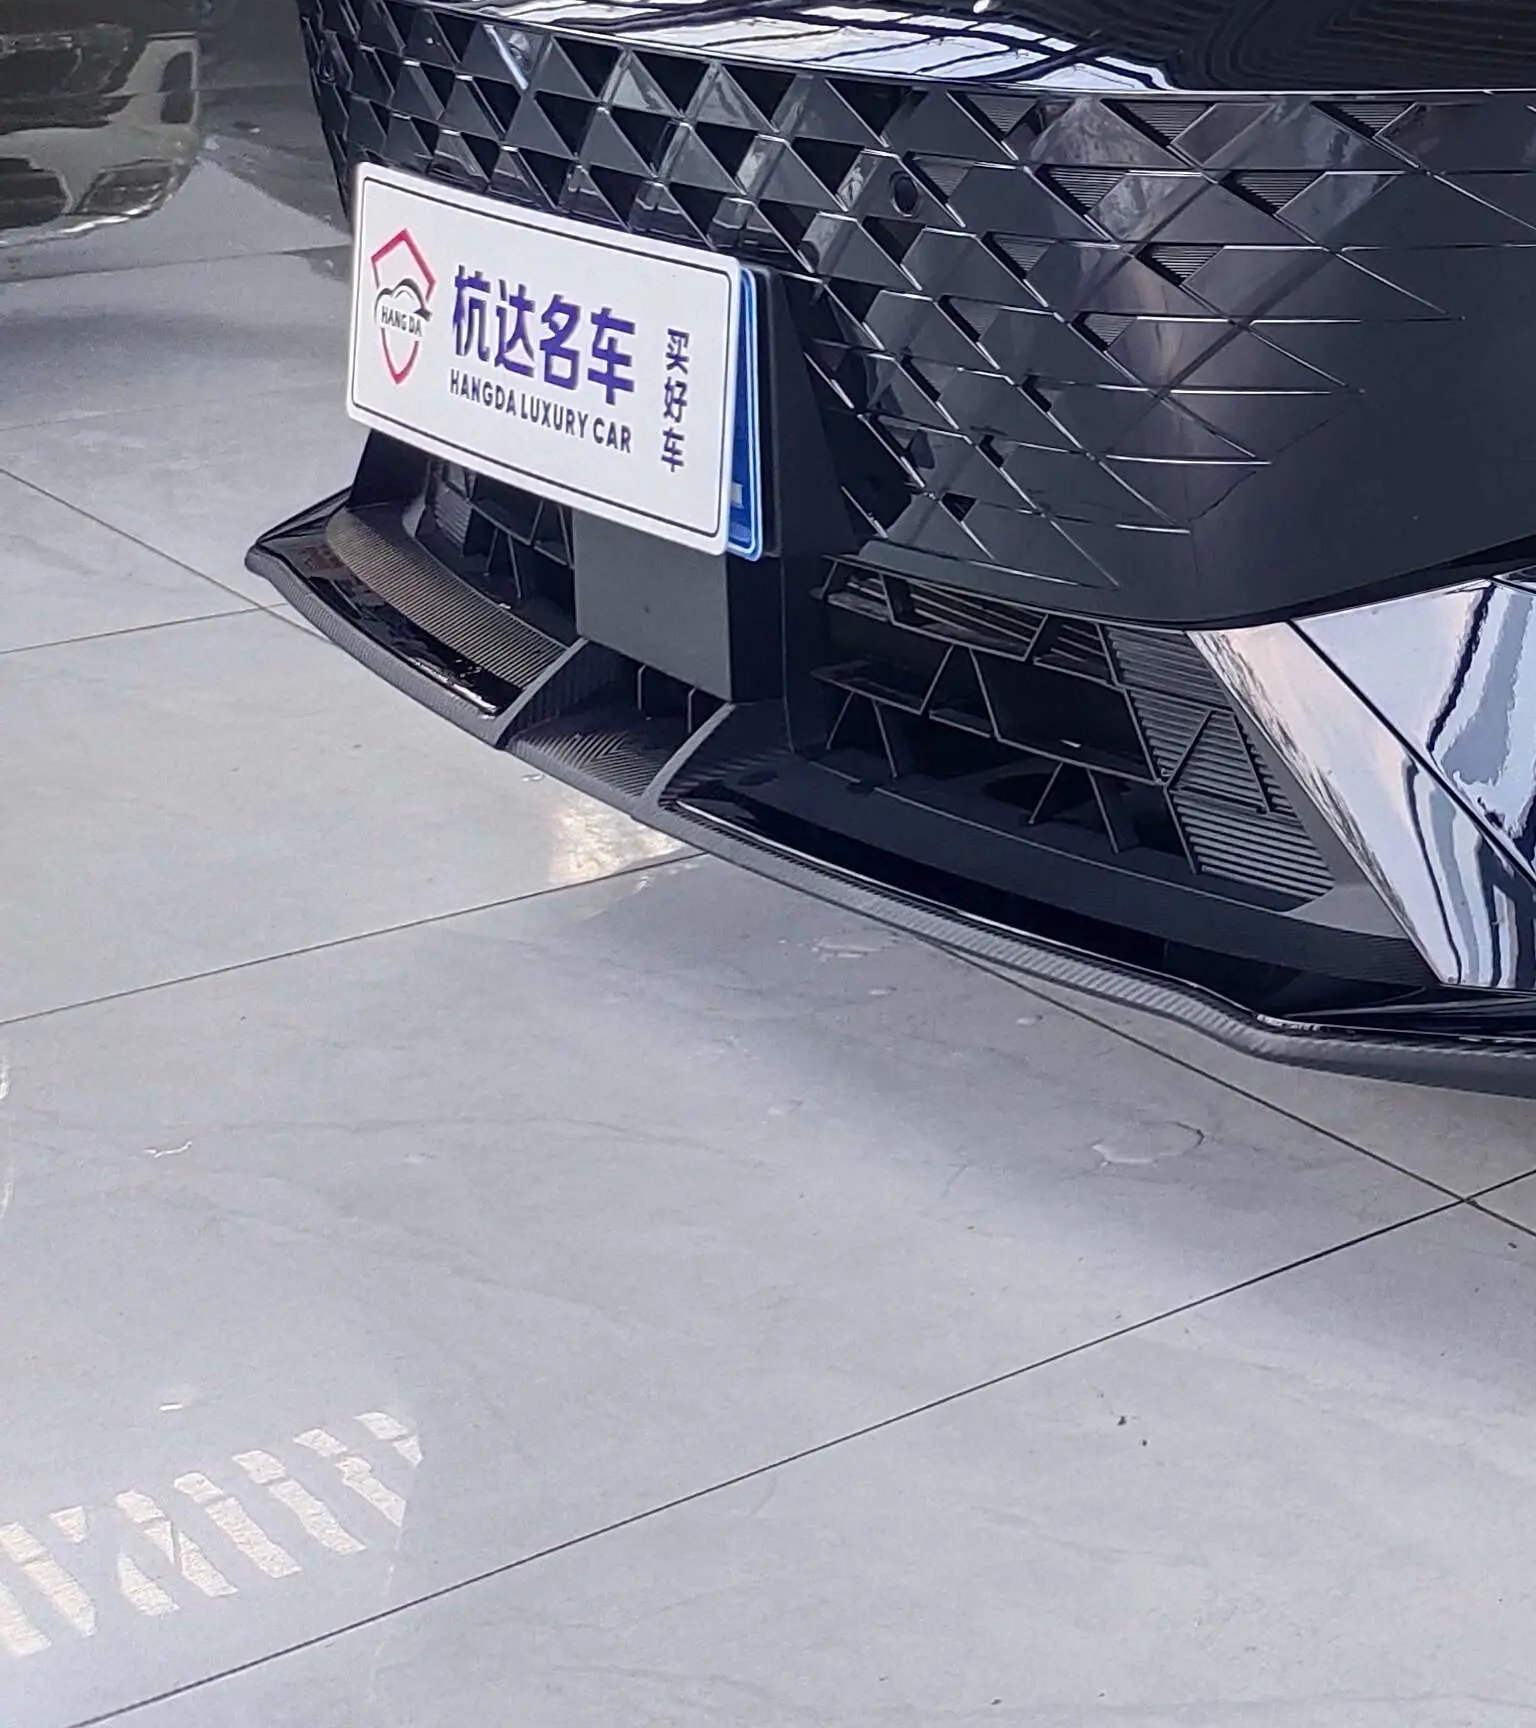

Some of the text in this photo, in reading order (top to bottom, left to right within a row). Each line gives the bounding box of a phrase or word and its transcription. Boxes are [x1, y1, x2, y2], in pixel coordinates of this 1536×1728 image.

[381, 305, 408, 332] HANG
[453, 265, 636, 406] 杭达名车
[450, 368, 632, 454] HANGDA LUXURY CAR
[661, 328, 690, 472] 买好车
